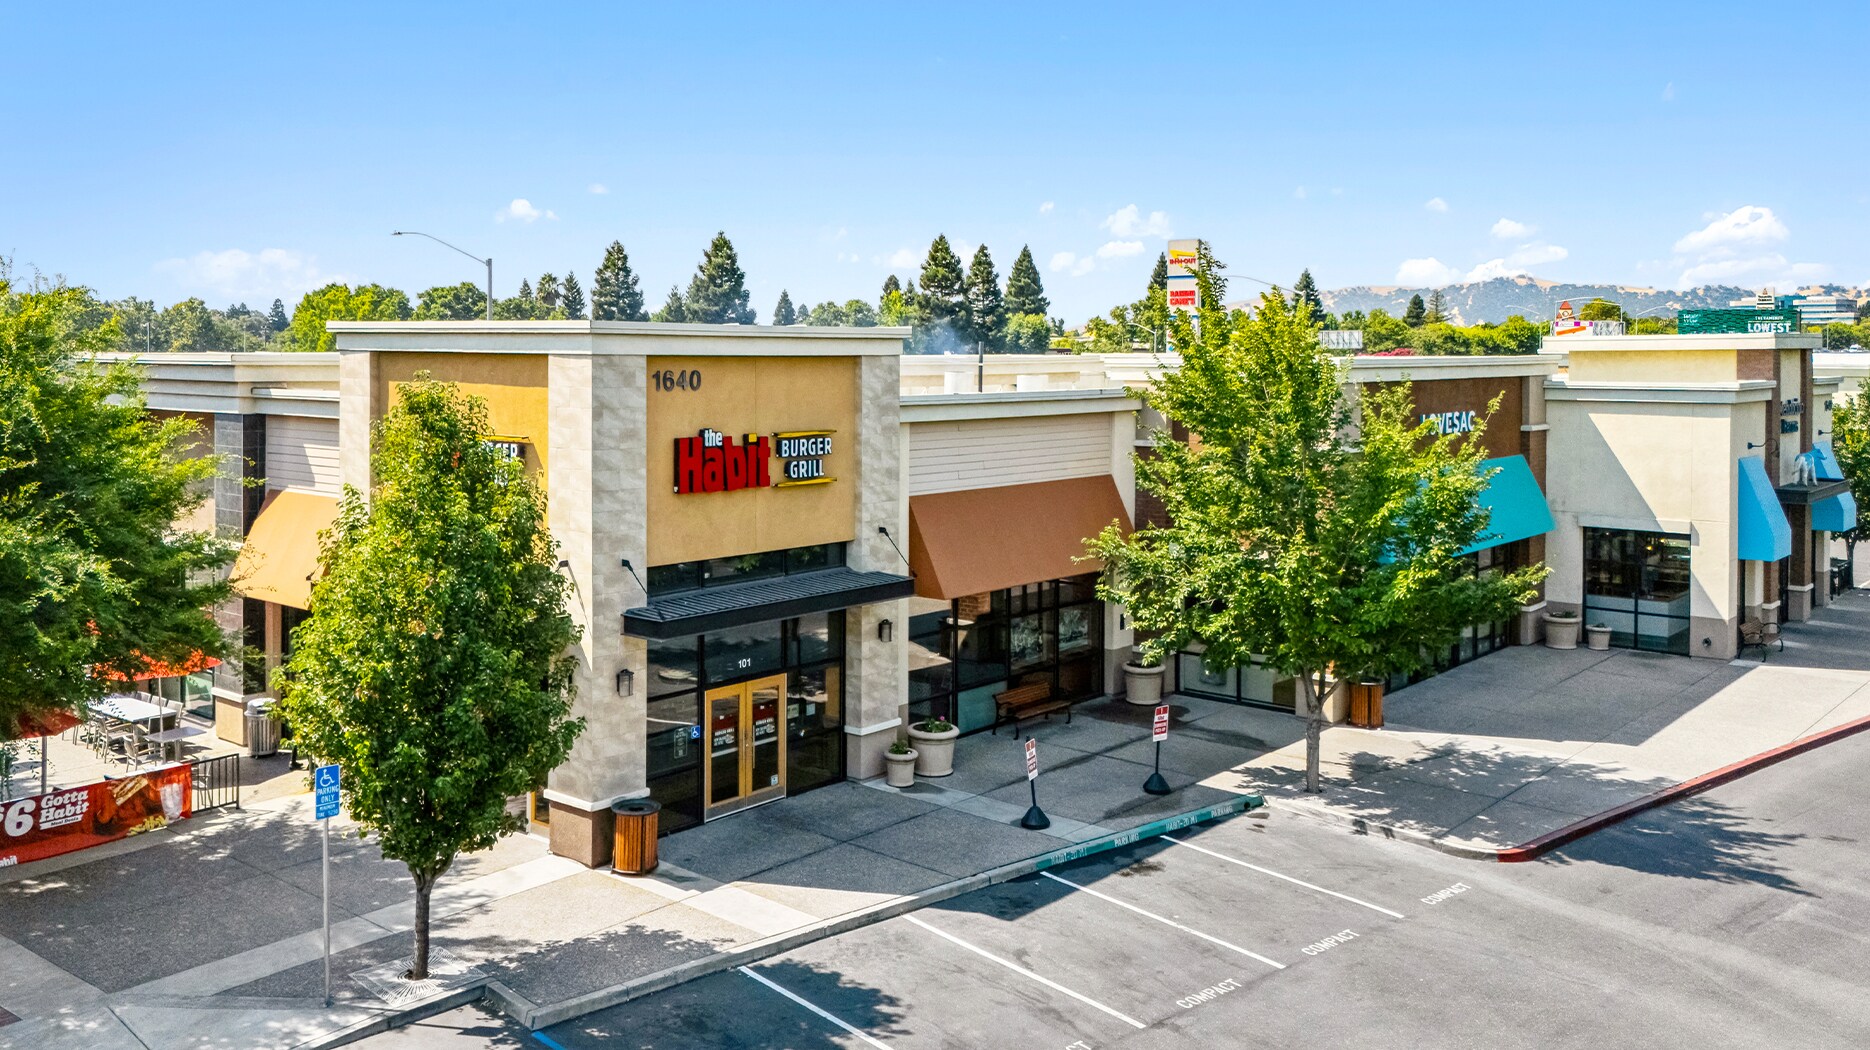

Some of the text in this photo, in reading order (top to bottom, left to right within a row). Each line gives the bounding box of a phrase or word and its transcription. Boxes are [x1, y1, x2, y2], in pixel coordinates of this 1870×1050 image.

[1748, 322, 1791, 333] LOWEST
[652, 370, 702, 392] 1640
[704, 429, 723, 447] the
[780, 437, 832, 458] BURGER
[674, 432, 771, 494] Habit
[789, 459, 825, 478] GRILL
[738, 657, 751, 669] 101
[41, 790, 89, 809] Gotta
[317, 784, 339, 796] PARKING
[320, 794, 335, 803] ONLY
[39, 801, 90, 823] Habit
[1114, 833, 1140, 847] PARKING
[1421, 882, 1472, 905] COMPACT
[1301, 928, 1360, 956] COMPACT
[1176, 978, 1242, 1009] COMPACT
